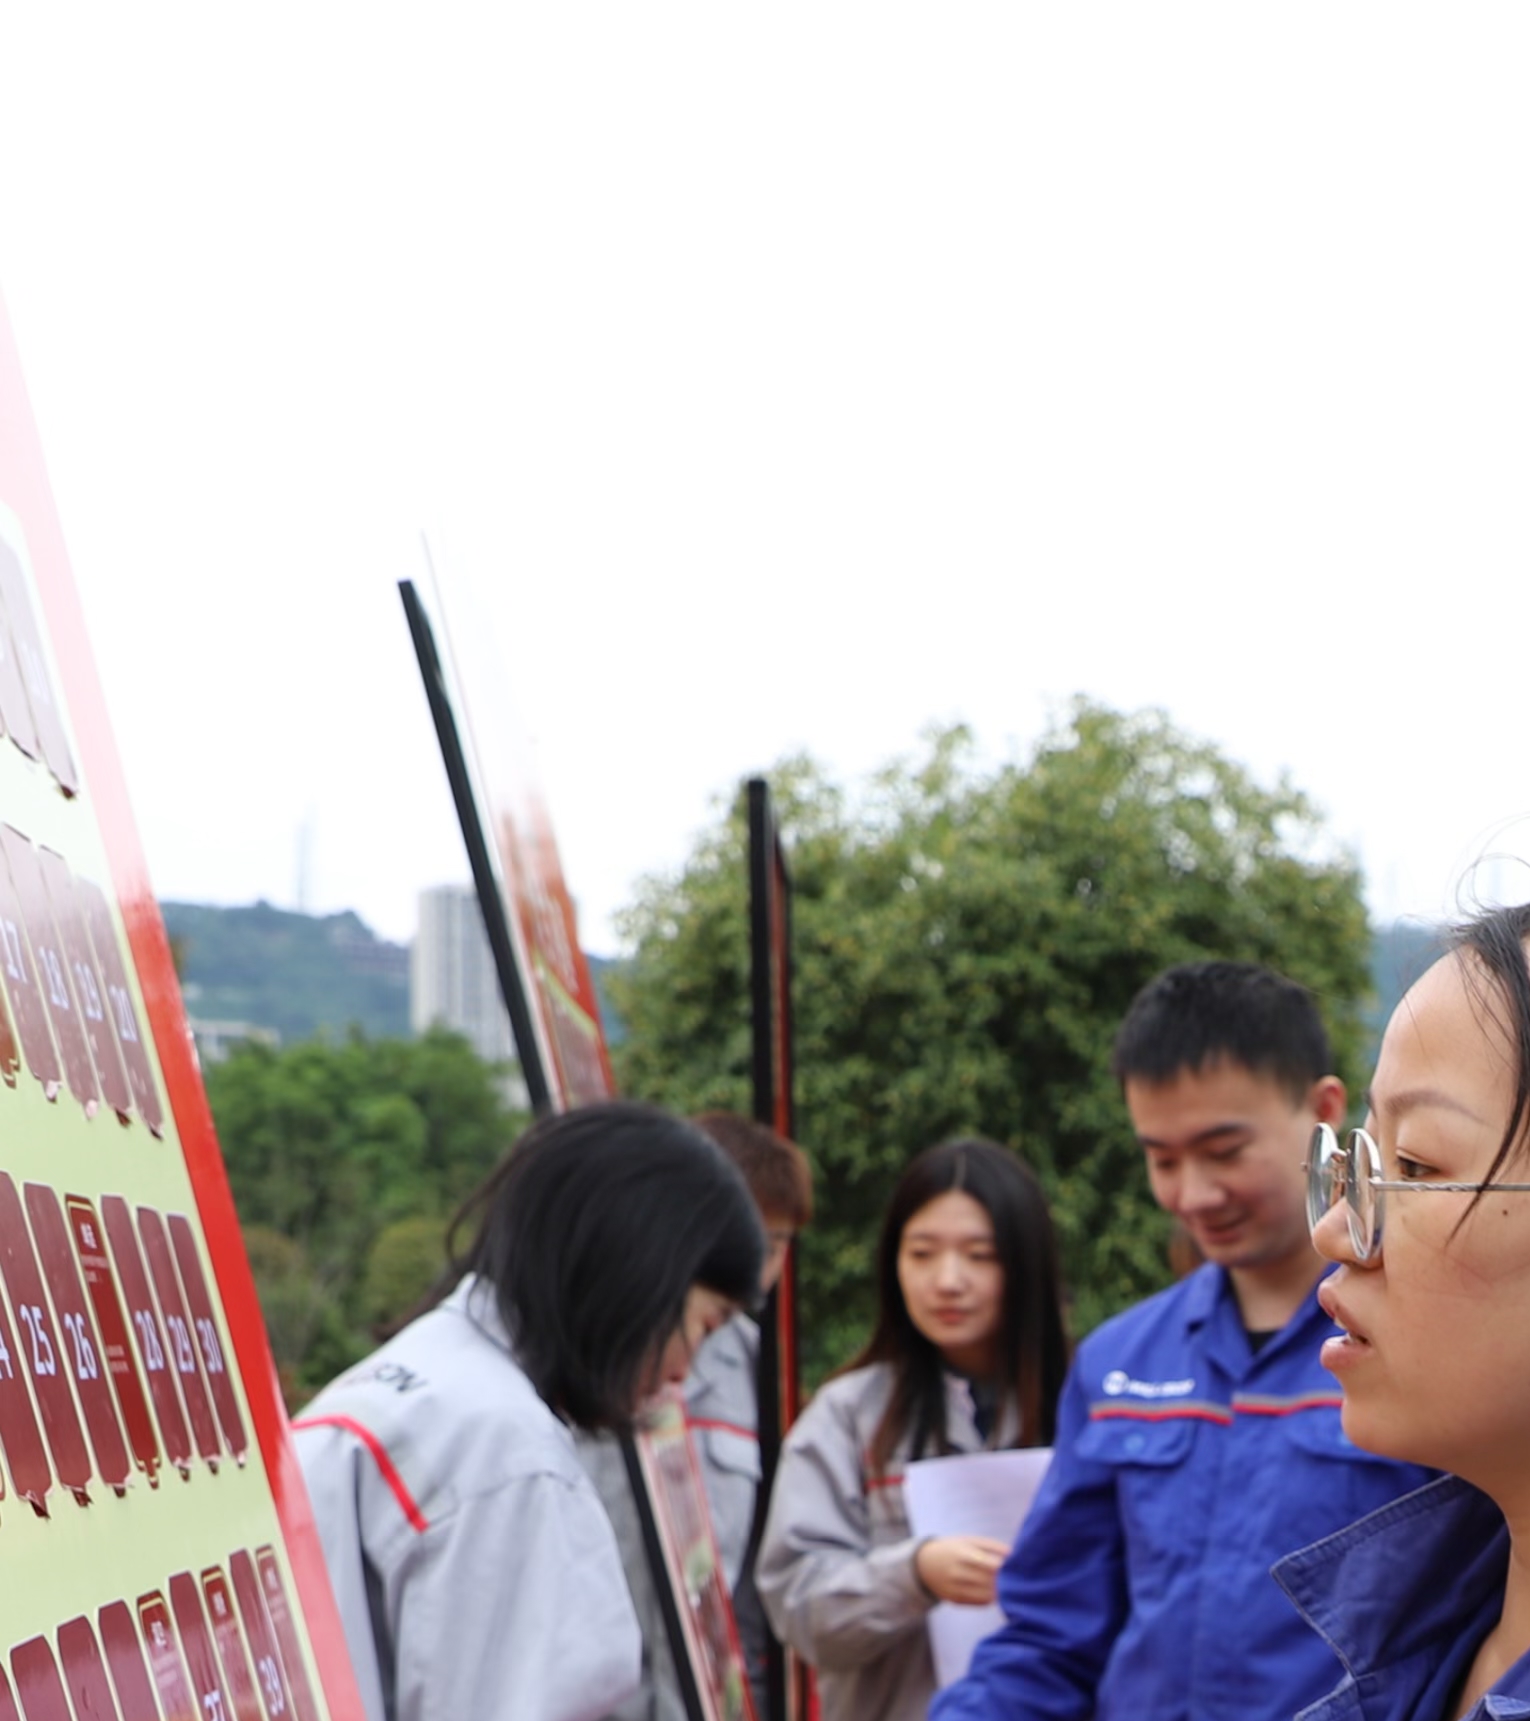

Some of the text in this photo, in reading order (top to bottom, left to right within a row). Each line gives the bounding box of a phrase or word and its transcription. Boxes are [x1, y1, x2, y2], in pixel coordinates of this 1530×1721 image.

[0, 1331, 13, 1378] 4
[20, 1304, 56, 1376] 25
[64, 1313, 97, 1380] 26
[135, 1311, 164, 1371] 28
[167, 1316, 195, 1373] 29
[197, 1319, 223, 1373] 30
[259, 1656, 285, 1715] 39
